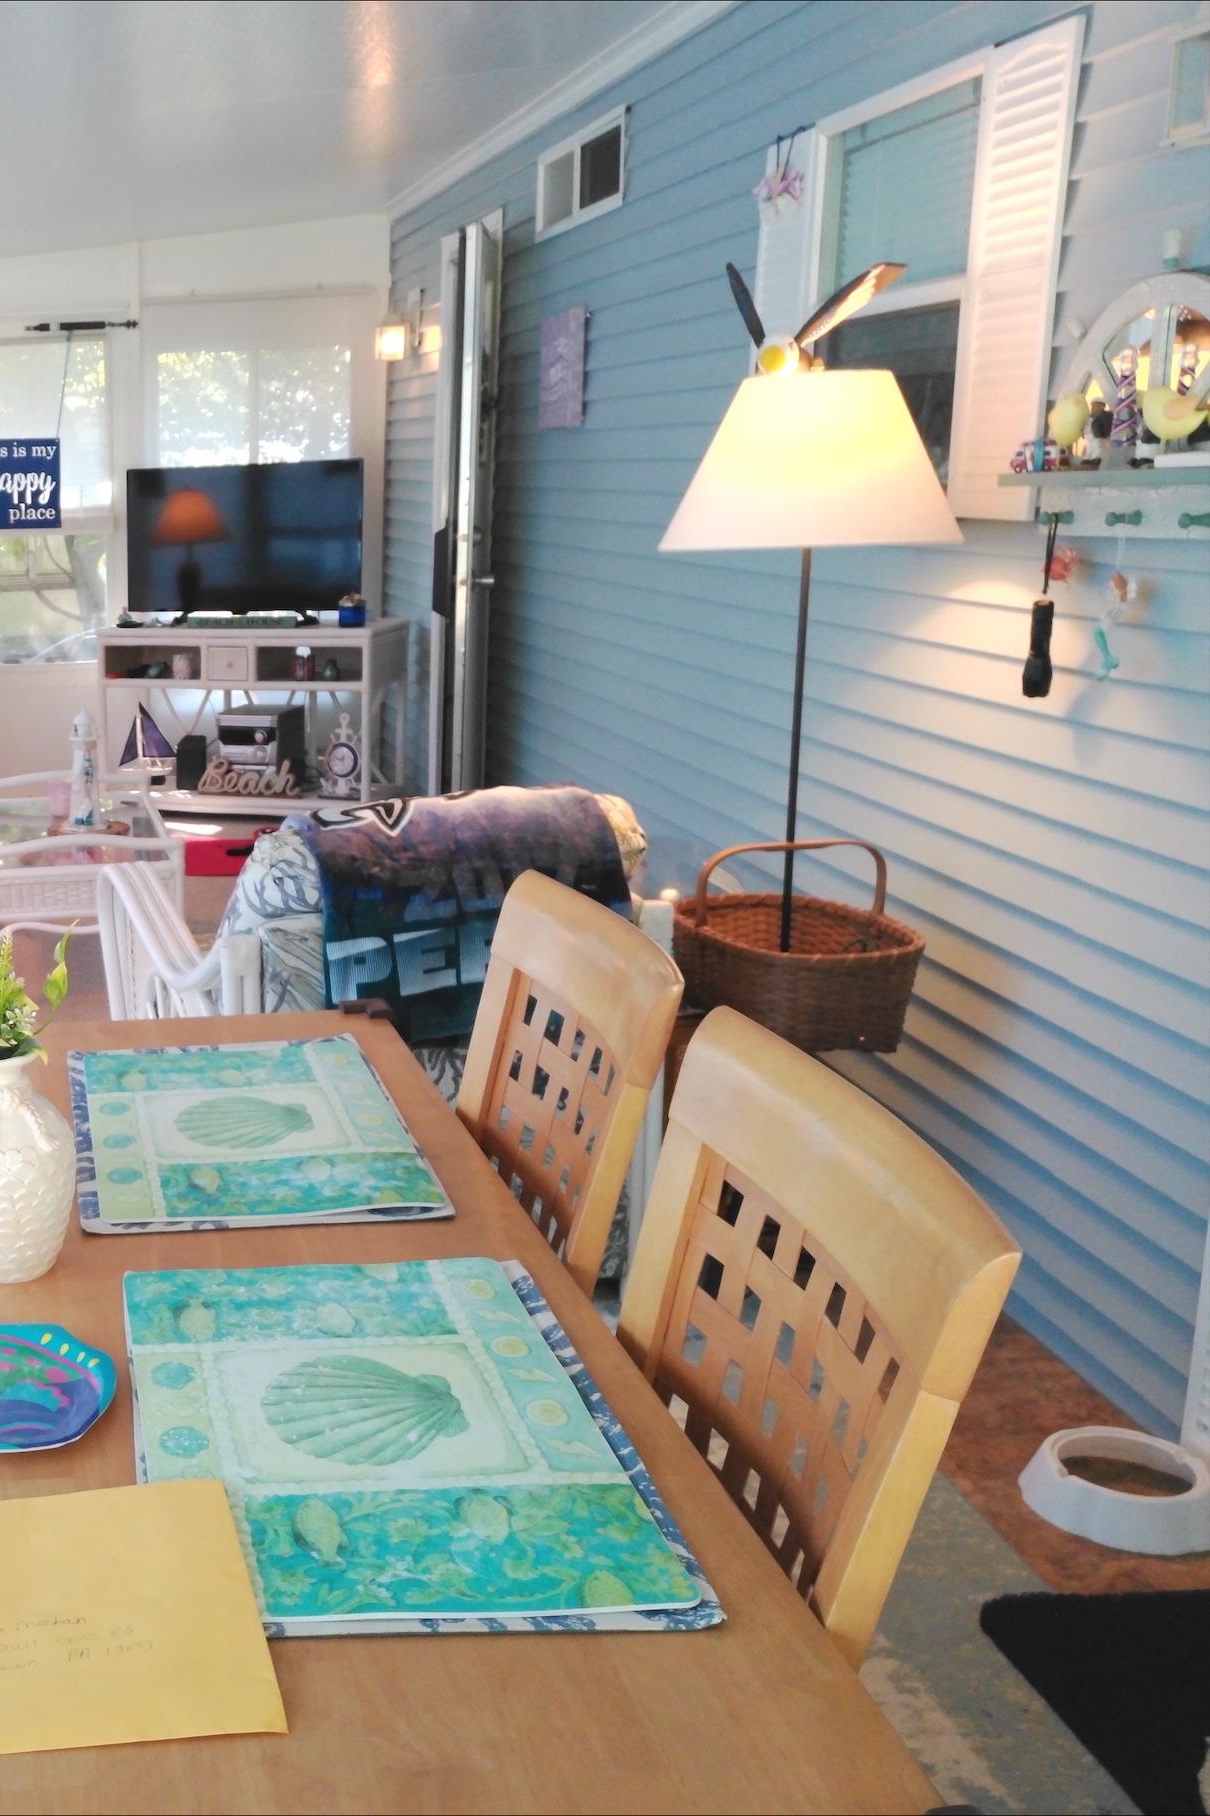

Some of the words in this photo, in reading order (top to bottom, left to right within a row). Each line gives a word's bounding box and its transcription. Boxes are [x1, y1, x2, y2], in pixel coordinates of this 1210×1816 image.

[13, 442, 27, 457] is
[32, 445, 57, 460] my
[9, 503, 56, 524] place
[198, 755, 301, 796] Beach
